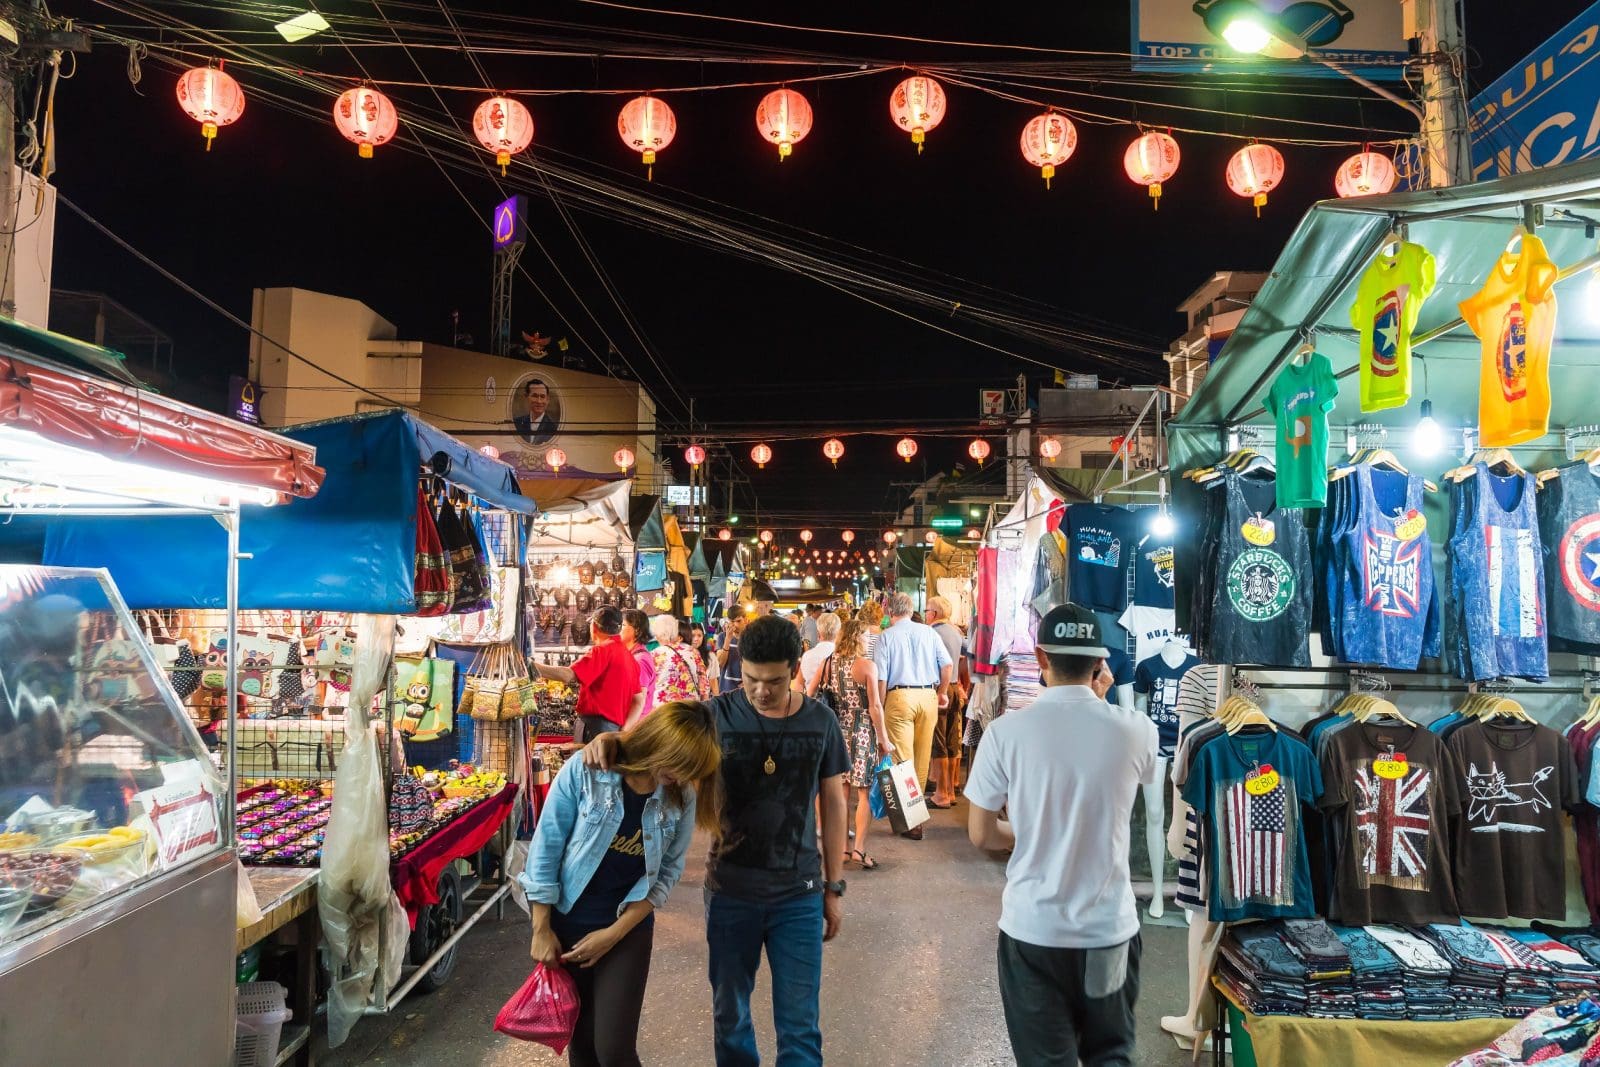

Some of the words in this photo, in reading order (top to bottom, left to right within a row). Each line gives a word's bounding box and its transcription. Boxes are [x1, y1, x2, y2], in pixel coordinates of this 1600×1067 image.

[1146, 45, 1191, 58] TOP
[1077, 533, 1112, 544] THAILAND
[1098, 528, 1112, 537] HIN
[1231, 551, 1290, 584] STARBUCKS
[1238, 597, 1281, 617] COFFEE
[884, 784, 897, 810] ROXY
